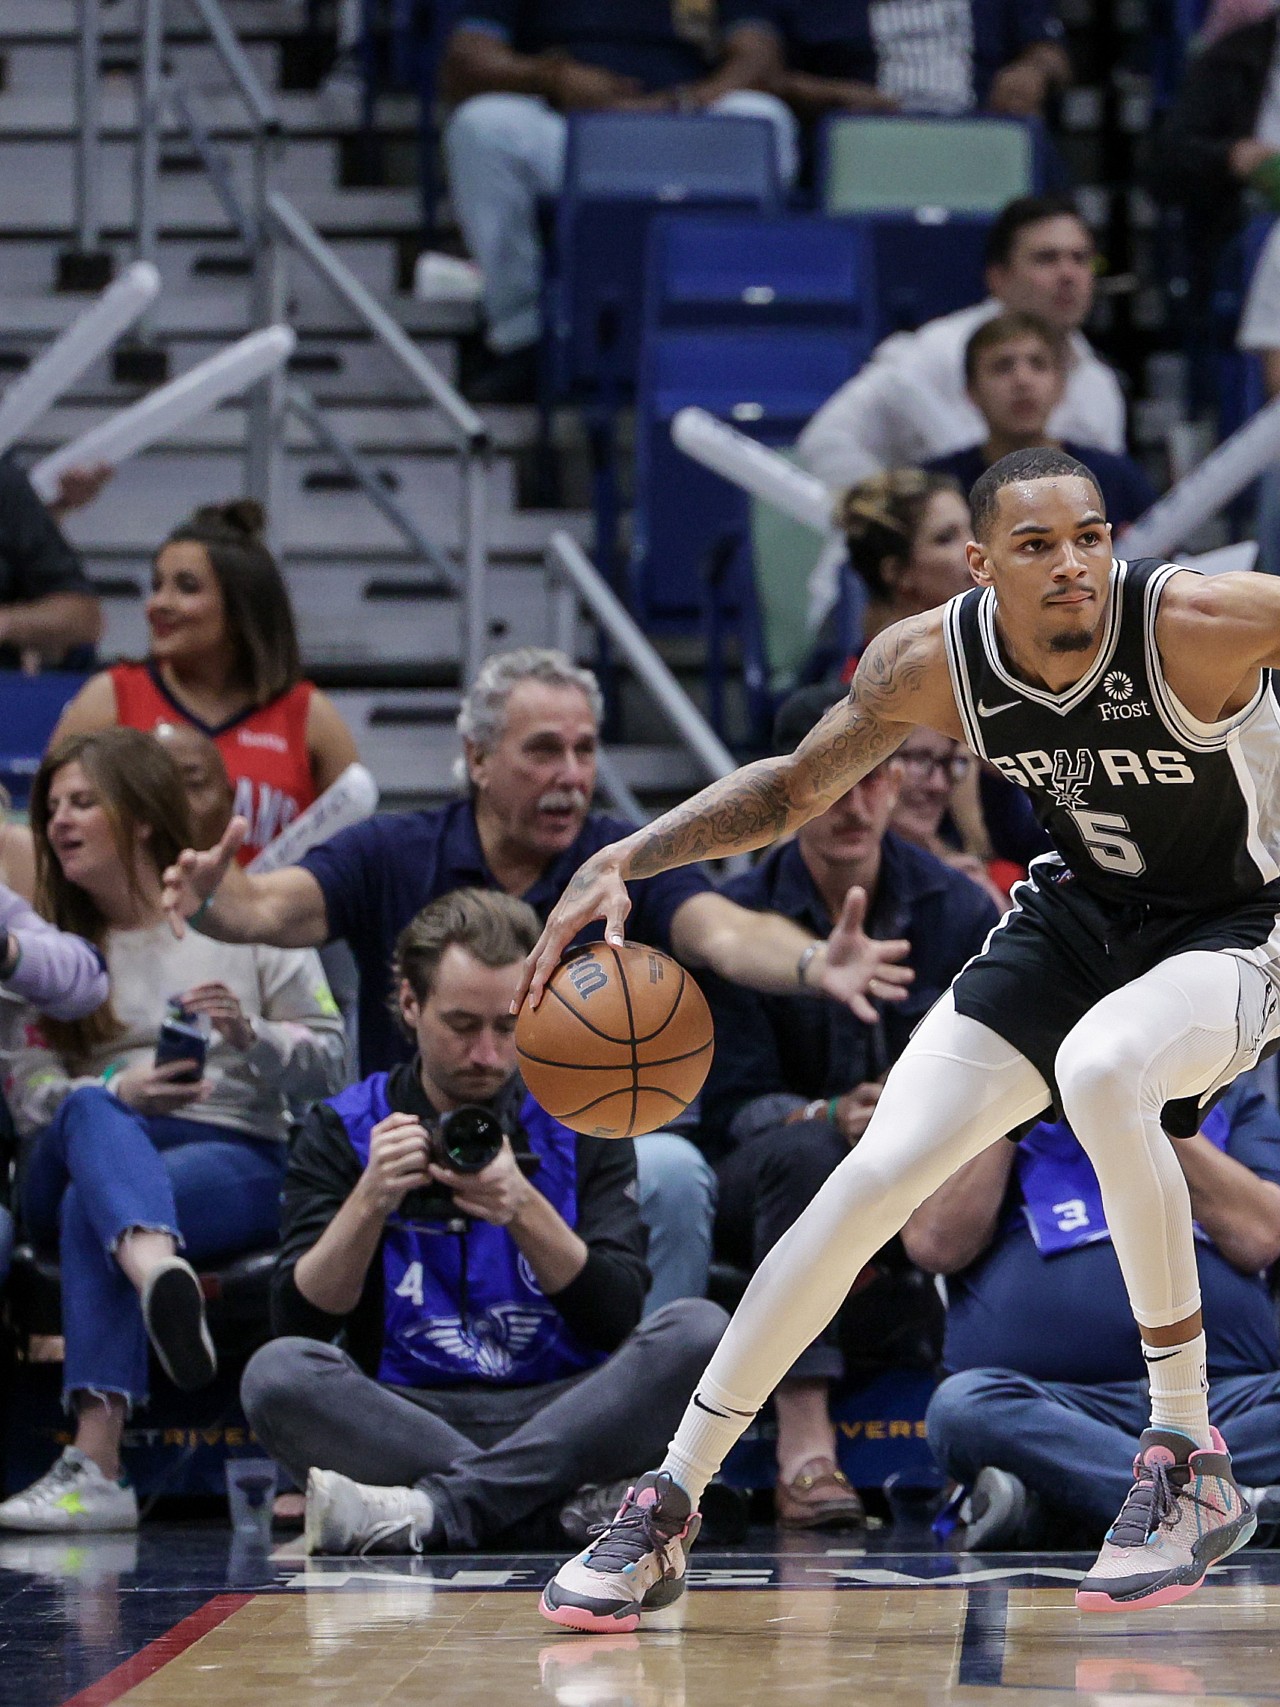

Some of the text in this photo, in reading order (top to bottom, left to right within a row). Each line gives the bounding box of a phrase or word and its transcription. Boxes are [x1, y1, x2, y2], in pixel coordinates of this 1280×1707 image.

[1098, 699, 1151, 722] Frost
[1065, 808, 1147, 878] 5
[1051, 1199, 1090, 1232] 3
[394, 1261, 424, 1306] 4
